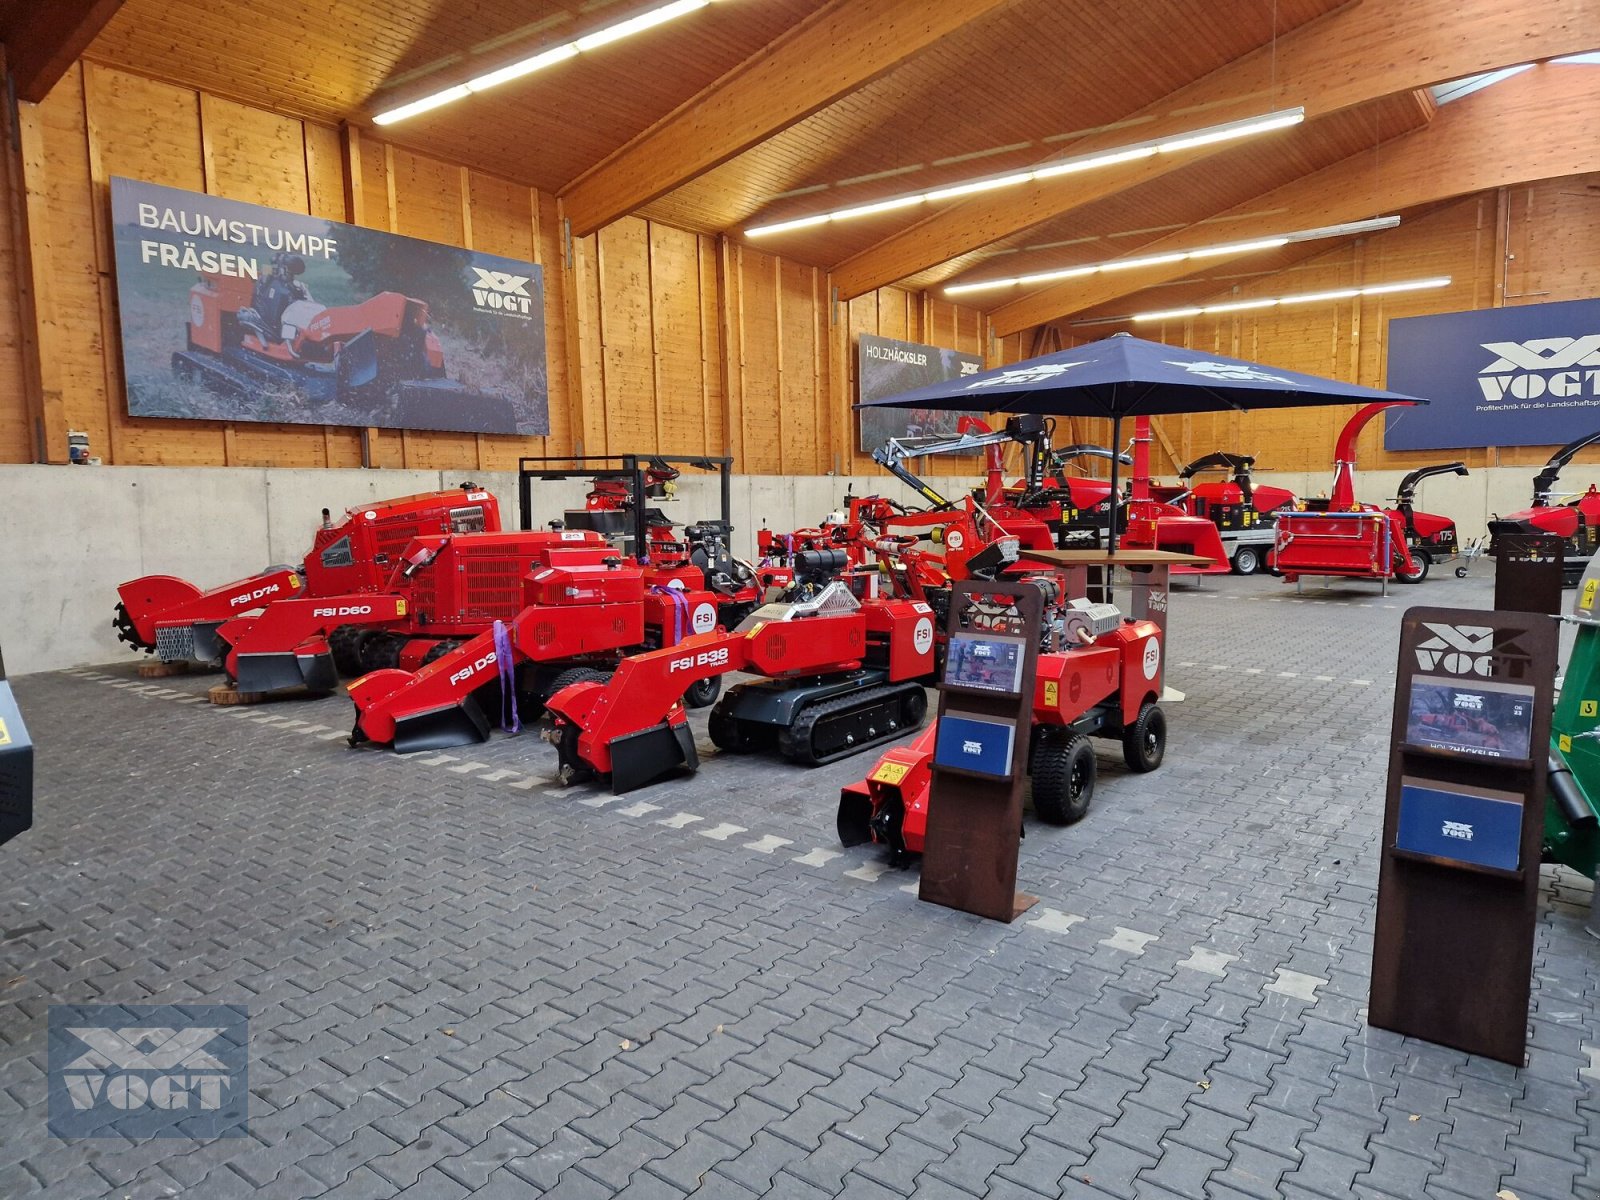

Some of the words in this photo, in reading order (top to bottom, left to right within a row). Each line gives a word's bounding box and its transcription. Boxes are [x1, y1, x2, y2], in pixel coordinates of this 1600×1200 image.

[138, 203, 337, 259] BAUMSTUMPF
[141, 240, 258, 280] FRÄSEN
[472, 289, 532, 313] VOGT
[866, 345, 927, 366] HOLZHÄCKSLER
[230, 593, 251, 607] FSI
[252, 584, 280, 598] D74
[313, 608, 336, 617] FSI
[339, 606, 371, 616] D60
[696, 613, 713, 624] FSI
[916, 628, 931, 640] FSI
[670, 656, 694, 673] FSI
[697, 647, 729, 666] B38
[709, 658, 729, 667] TRACK
[1145, 649, 1158, 663] FSI
[1415, 649, 1532, 678] VOGT
[449, 665, 474, 686] FSI
[1453, 700, 1483, 709] VOGT
[1442, 828, 1473, 839] VOGT
